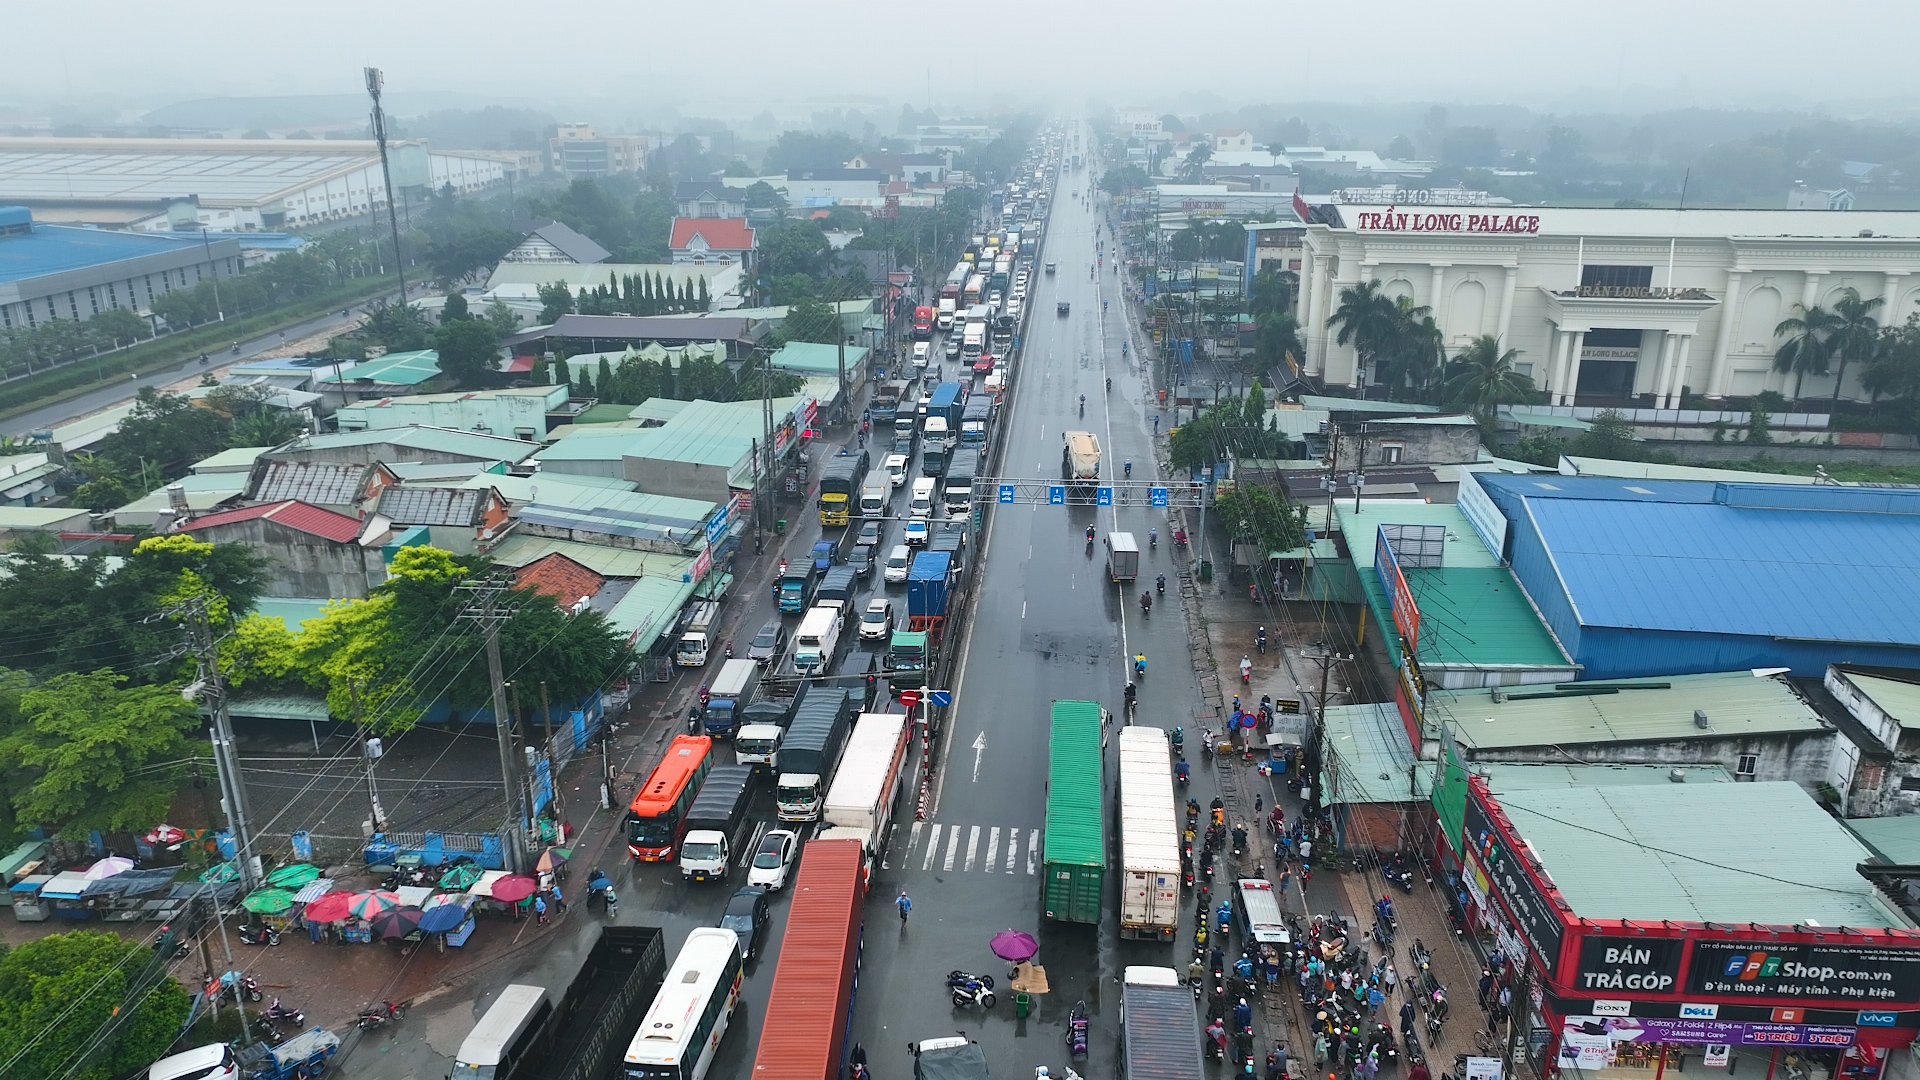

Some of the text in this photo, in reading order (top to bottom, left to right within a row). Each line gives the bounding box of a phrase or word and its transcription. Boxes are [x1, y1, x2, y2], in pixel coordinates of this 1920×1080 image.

[1358, 205, 1540, 233] TRẦN LONG PALACE
[1574, 280, 1707, 300] TRẦN LONG PALACE
[1605, 944, 1650, 964] BÁN
[1584, 969, 1672, 990] TRẢ GÓP
[1705, 982, 1896, 999] Đện thoại Máy tính Phụ kiện
[1647, 1020, 1676, 1029] Galaxy
[1714, 1022, 1732, 1031] Flip4
[1754, 1032, 1766, 1041] 16
[1767, 1031, 1799, 1042] TRIỆU
[1809, 1033, 1850, 1045] 3 TRIỆU
